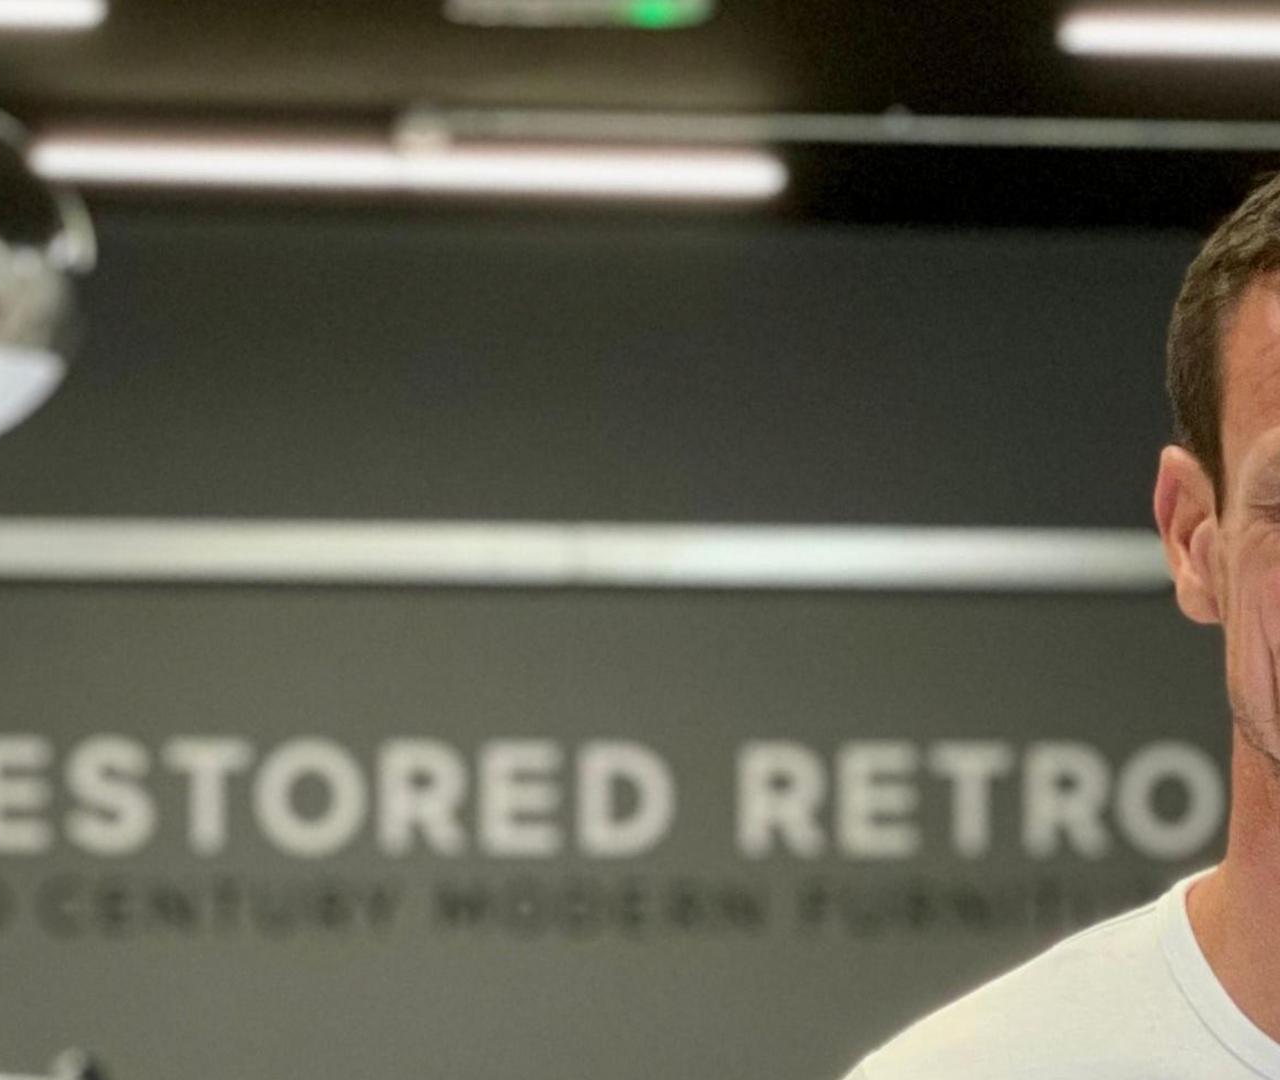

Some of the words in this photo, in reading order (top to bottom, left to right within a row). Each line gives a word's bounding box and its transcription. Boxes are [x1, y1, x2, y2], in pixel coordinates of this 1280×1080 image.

[735, 740, 1223, 860] RETRO
[34, 874, 404, 938] CENTURY
[433, 874, 767, 938] MODERN
